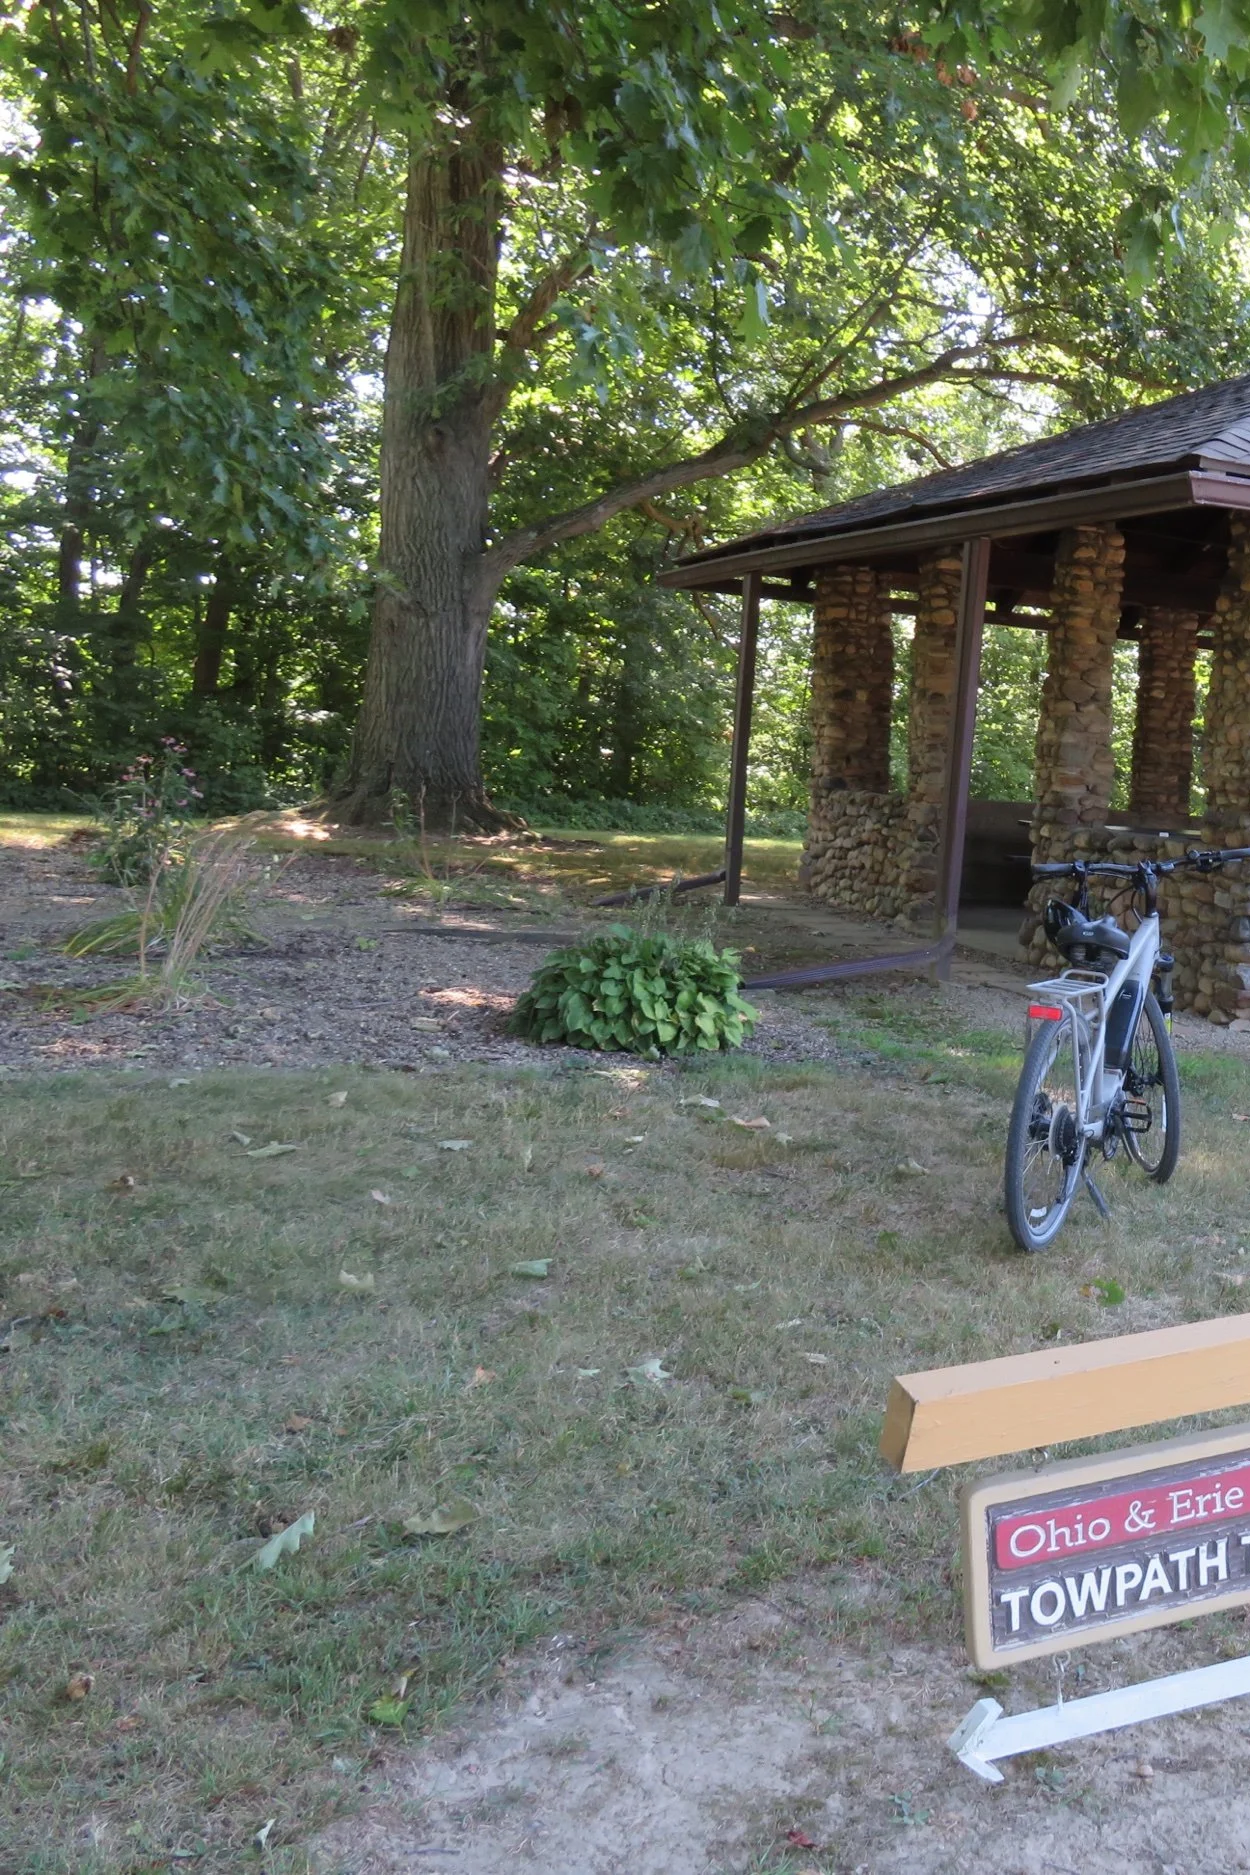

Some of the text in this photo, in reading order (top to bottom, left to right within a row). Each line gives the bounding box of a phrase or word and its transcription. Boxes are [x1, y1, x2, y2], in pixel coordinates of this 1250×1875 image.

[1009, 1516, 1111, 1559] Ohio
[1124, 1499, 1156, 1534] &
[1168, 1482, 1245, 1525] Erie
[1000, 1540, 1230, 1632] TOWPATH
